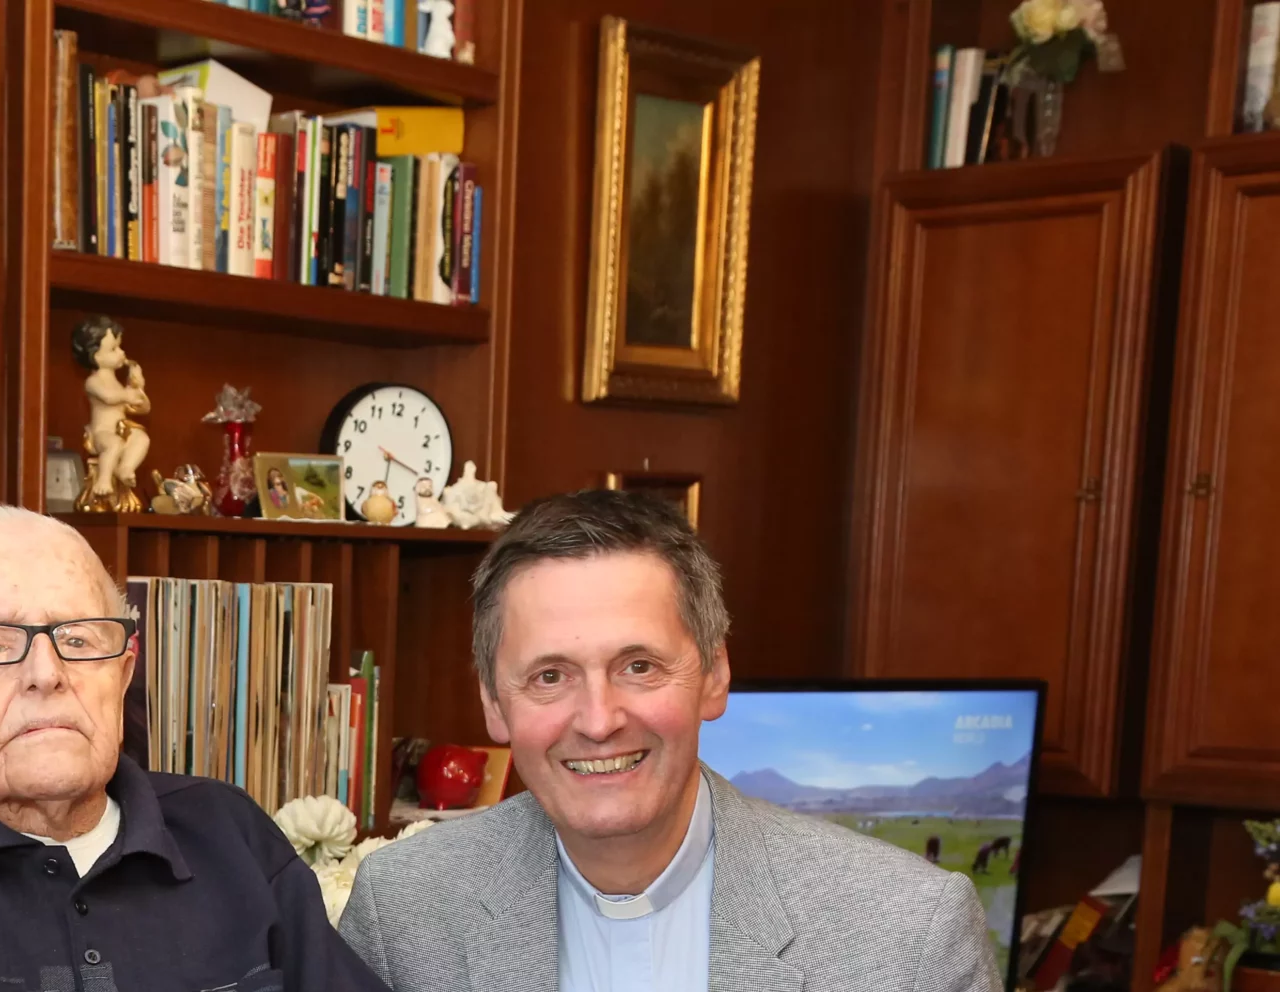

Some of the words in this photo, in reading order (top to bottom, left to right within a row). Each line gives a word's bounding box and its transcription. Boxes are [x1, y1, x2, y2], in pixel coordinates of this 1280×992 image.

[237, 226, 245, 249] Die
[371, 405, 383, 419] 11
[392, 402, 405, 417] 12
[353, 419, 367, 433] 10
[414, 415, 419, 429] 1
[344, 440, 352, 453] 9
[422, 435, 431, 448] 2
[344, 465, 353, 480] 8
[424, 460, 432, 473] 3
[356, 486, 365, 500] 7
[397, 496, 405, 509] 5
